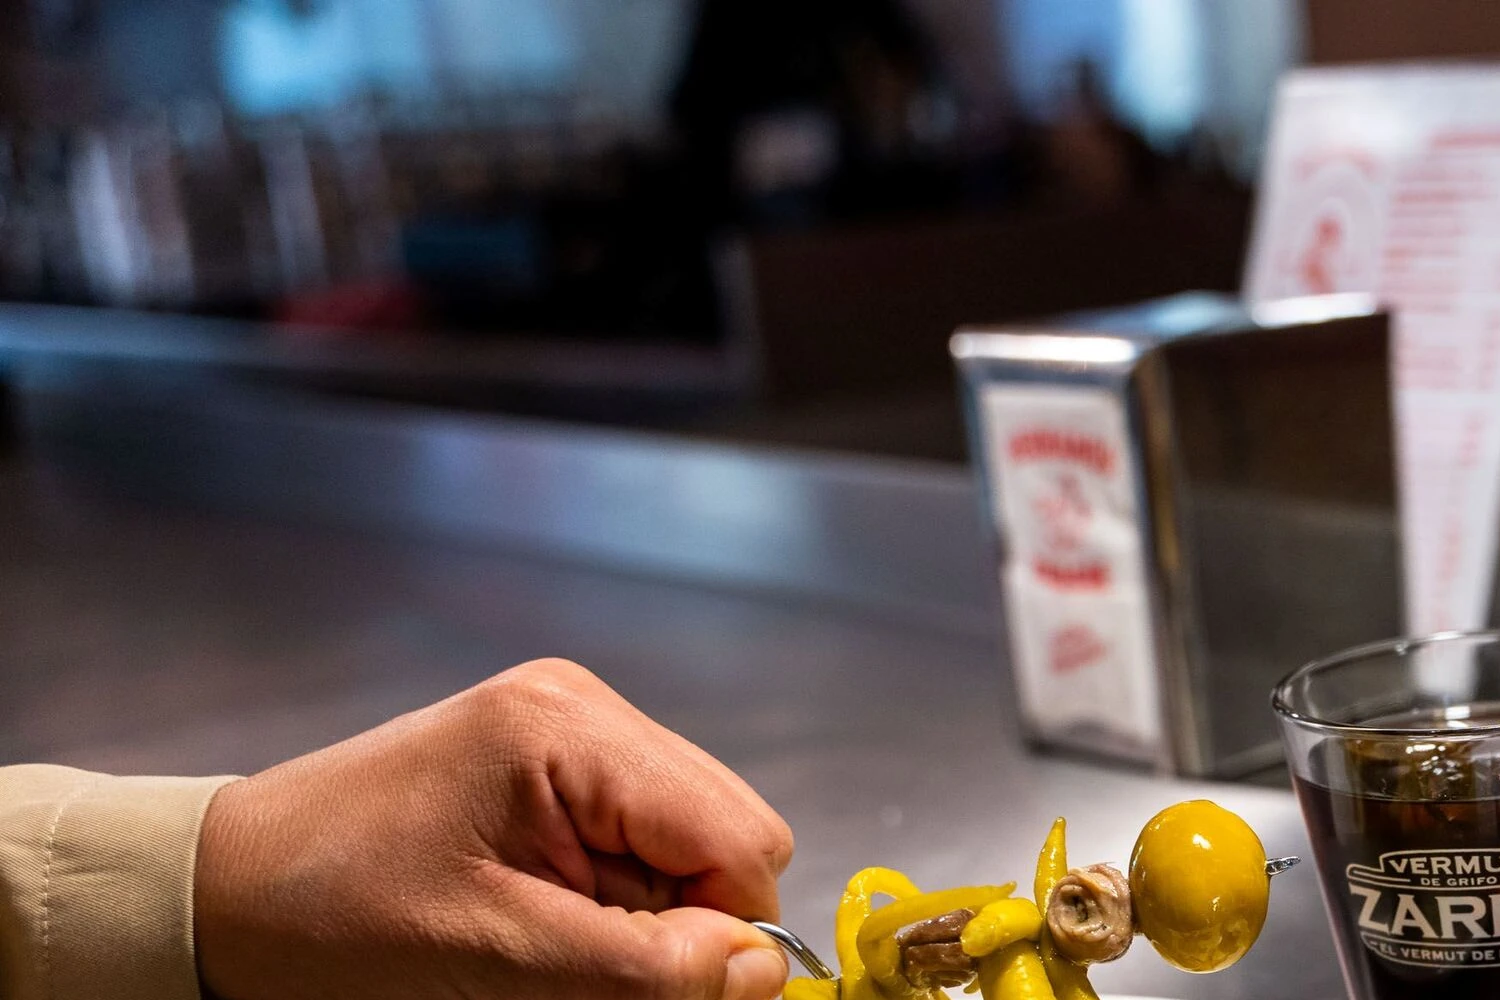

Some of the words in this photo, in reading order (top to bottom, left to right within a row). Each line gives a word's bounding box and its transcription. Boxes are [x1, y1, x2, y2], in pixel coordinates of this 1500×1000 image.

[1420, 877, 1441, 887] DE
[1446, 876, 1497, 887] GRIFO
[1379, 943, 1398, 957] EL
[1400, 948, 1467, 962] VERMUT
[1472, 949, 1496, 962] DE
